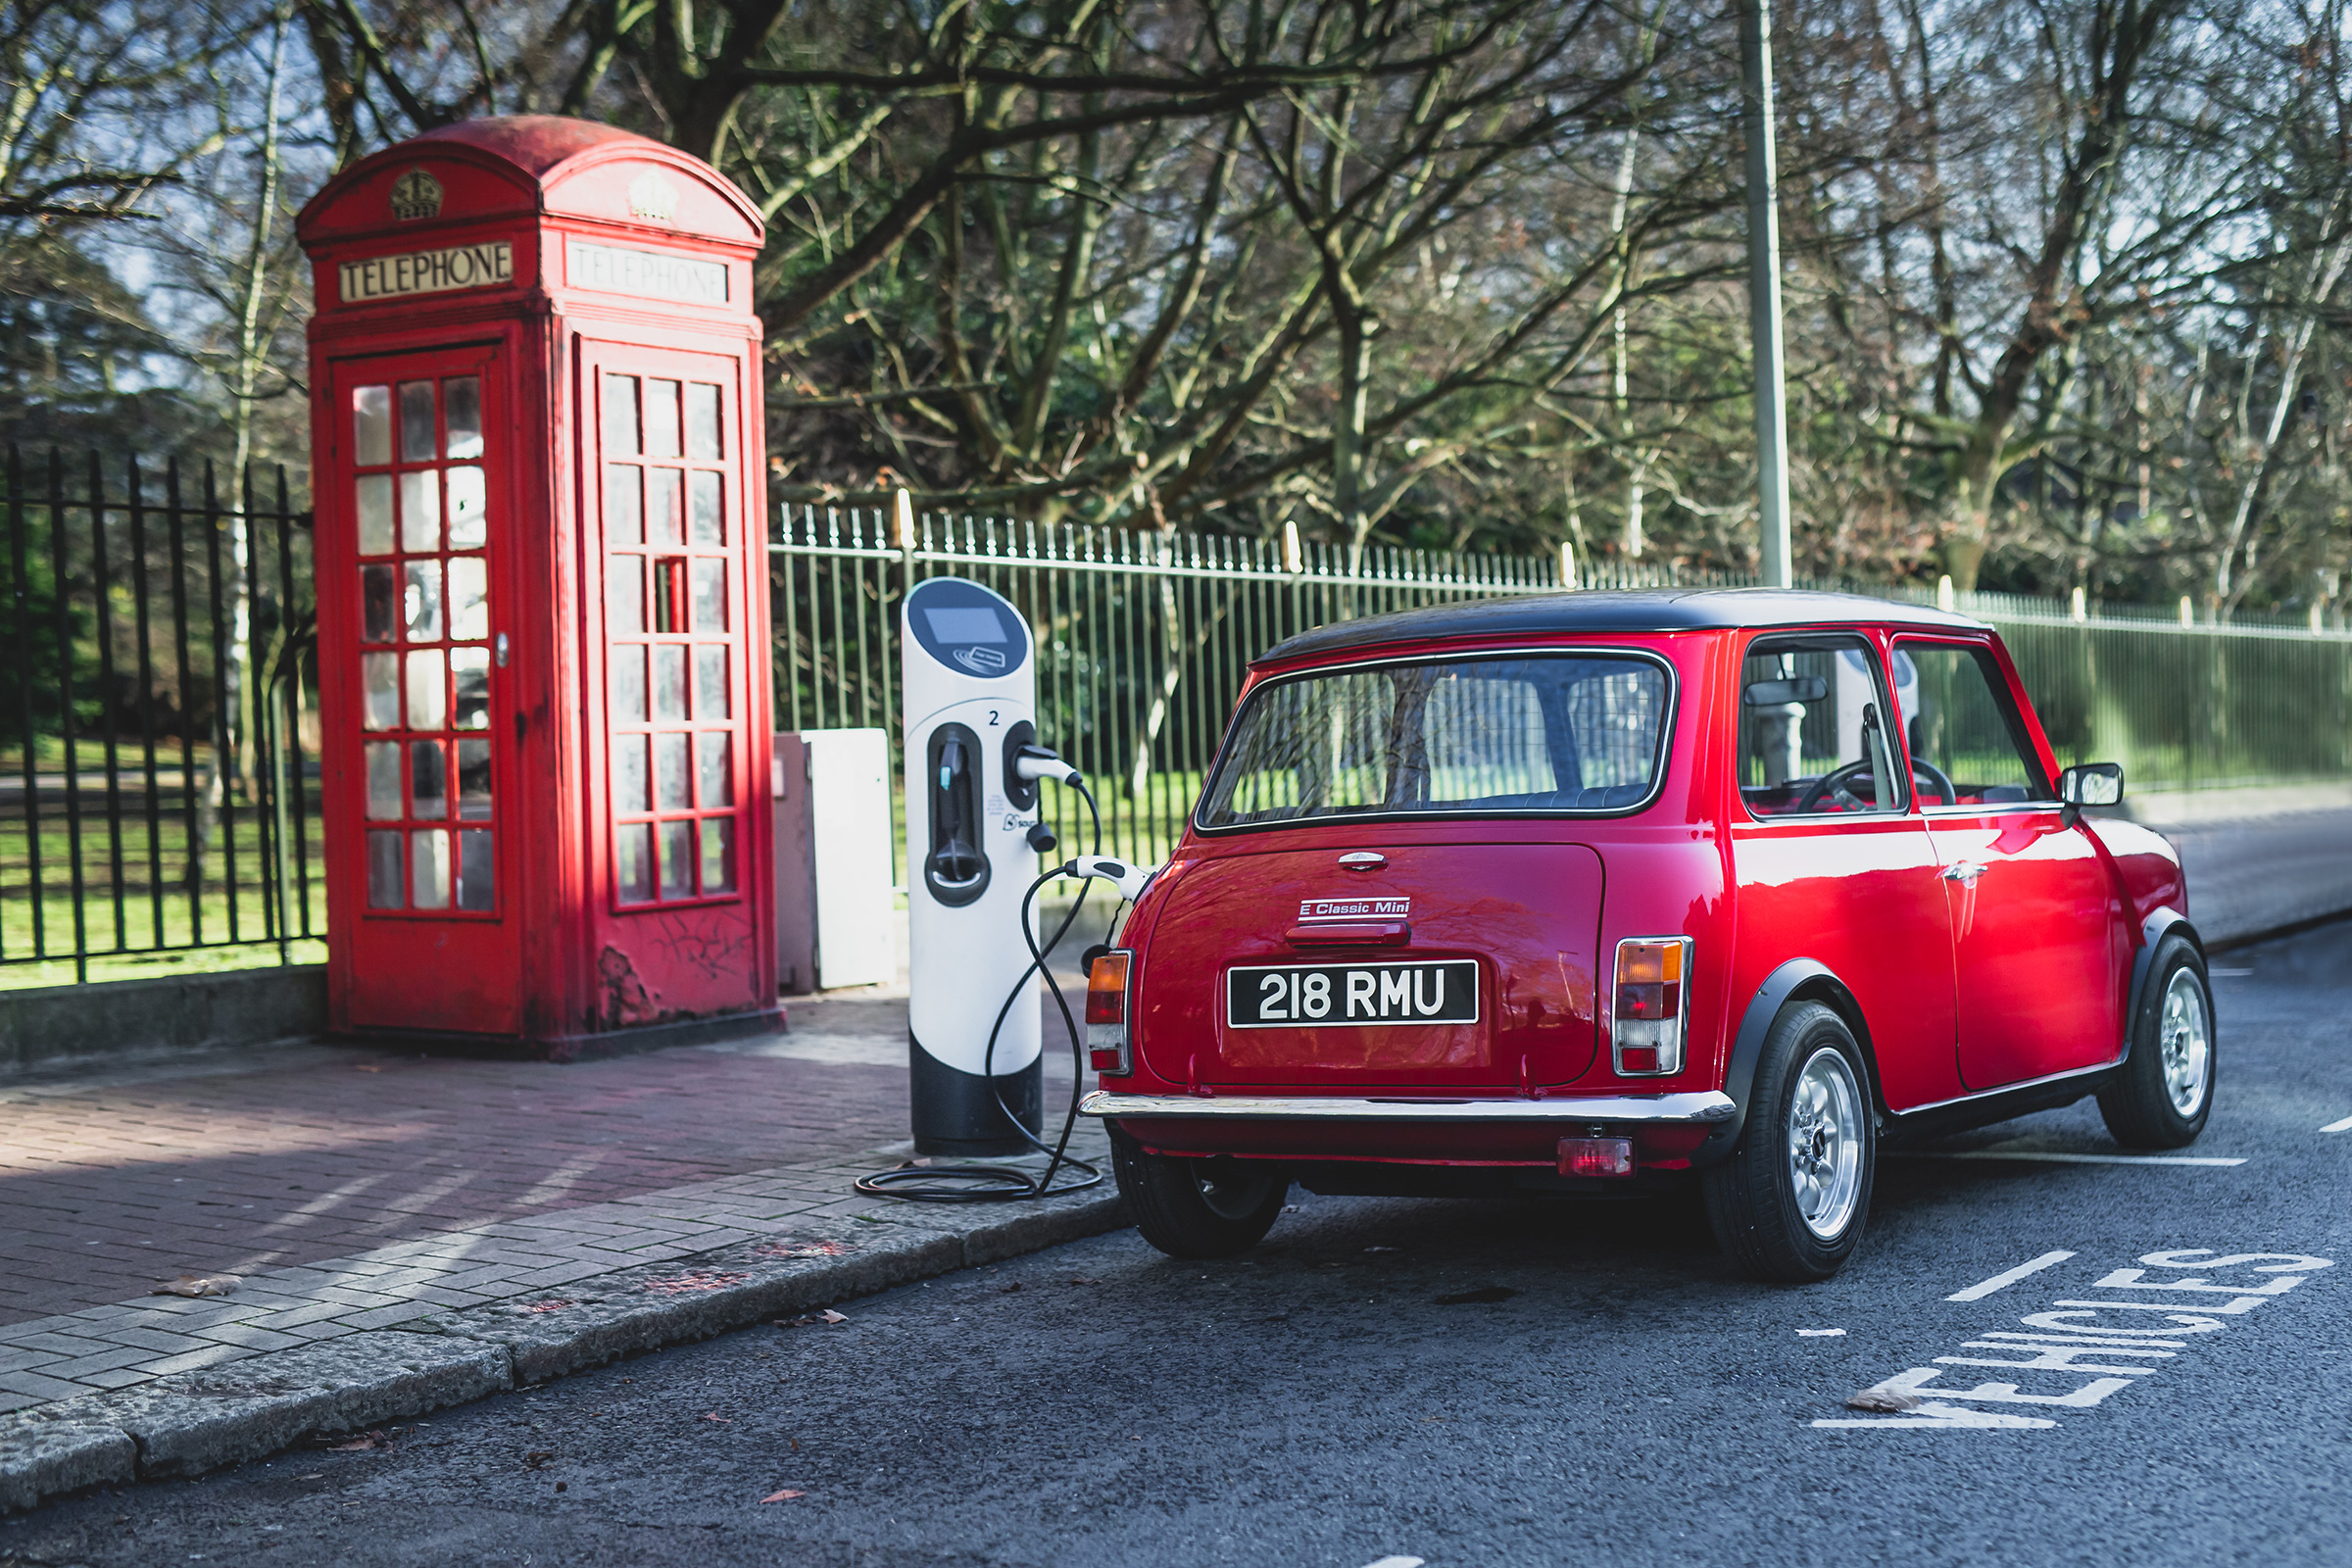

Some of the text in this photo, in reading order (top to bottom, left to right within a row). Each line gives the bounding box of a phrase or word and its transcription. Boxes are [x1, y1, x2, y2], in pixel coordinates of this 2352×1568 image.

[346, 245, 510, 296] TELEPHONE
[575, 248, 722, 300] TELEPHONE
[989, 710, 999, 726] 2
[1299, 901, 1410, 915] E Classic Mini
[1259, 968, 1445, 1019] 218 RMU
[1811, 1249, 2335, 1429] VEHICLES
